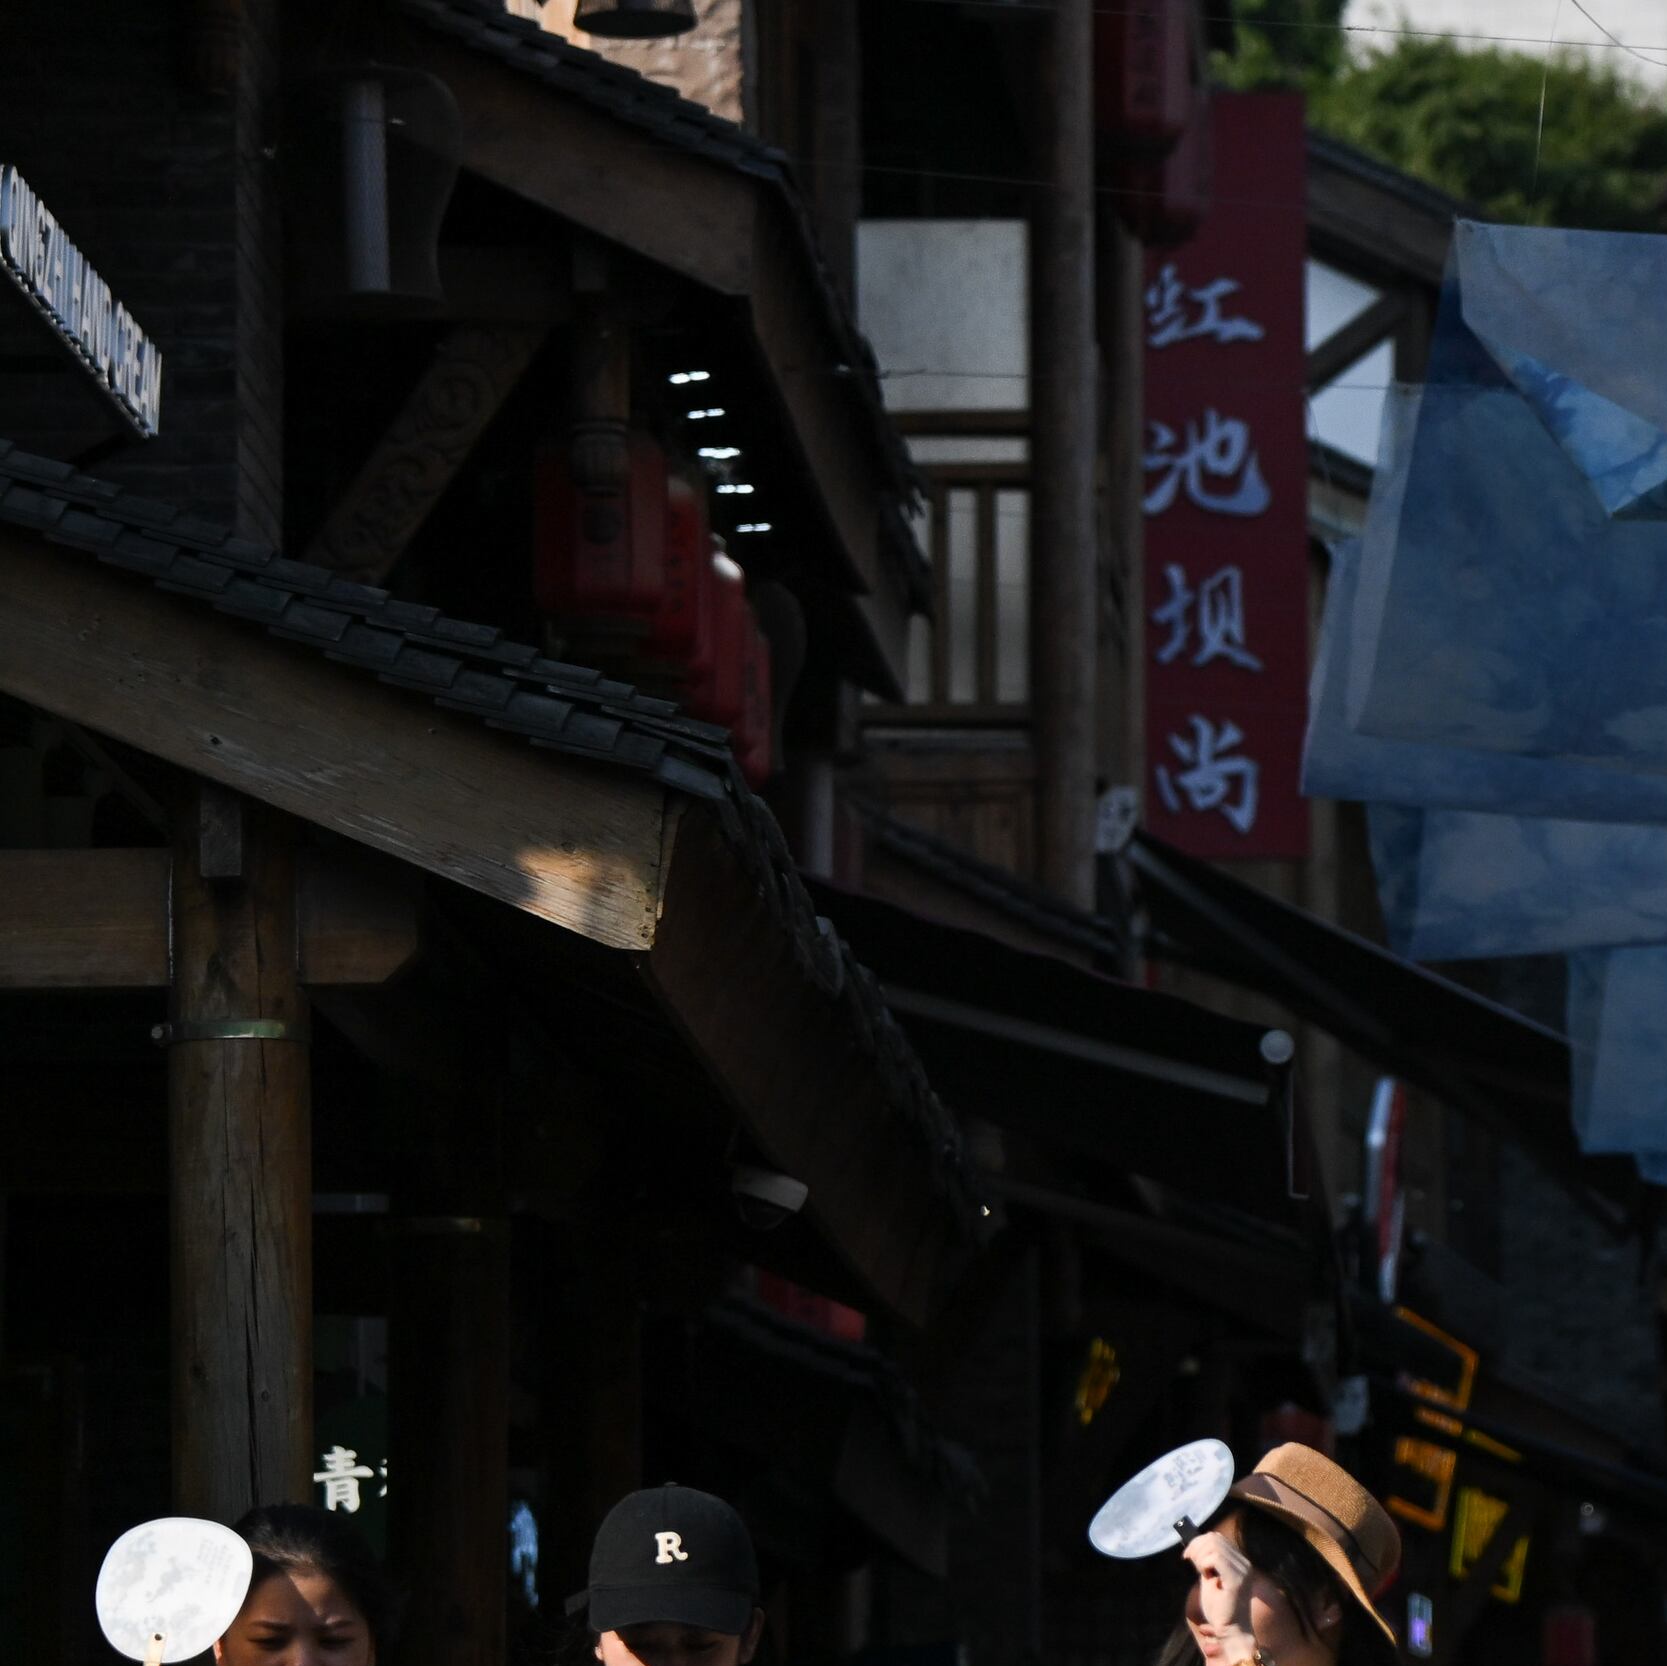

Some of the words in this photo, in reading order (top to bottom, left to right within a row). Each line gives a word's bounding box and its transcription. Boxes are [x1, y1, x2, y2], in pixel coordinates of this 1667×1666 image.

[71, 240, 112, 376] HAND
[113, 299, 162, 436] CREAM
[654, 1531, 689, 1565] R
